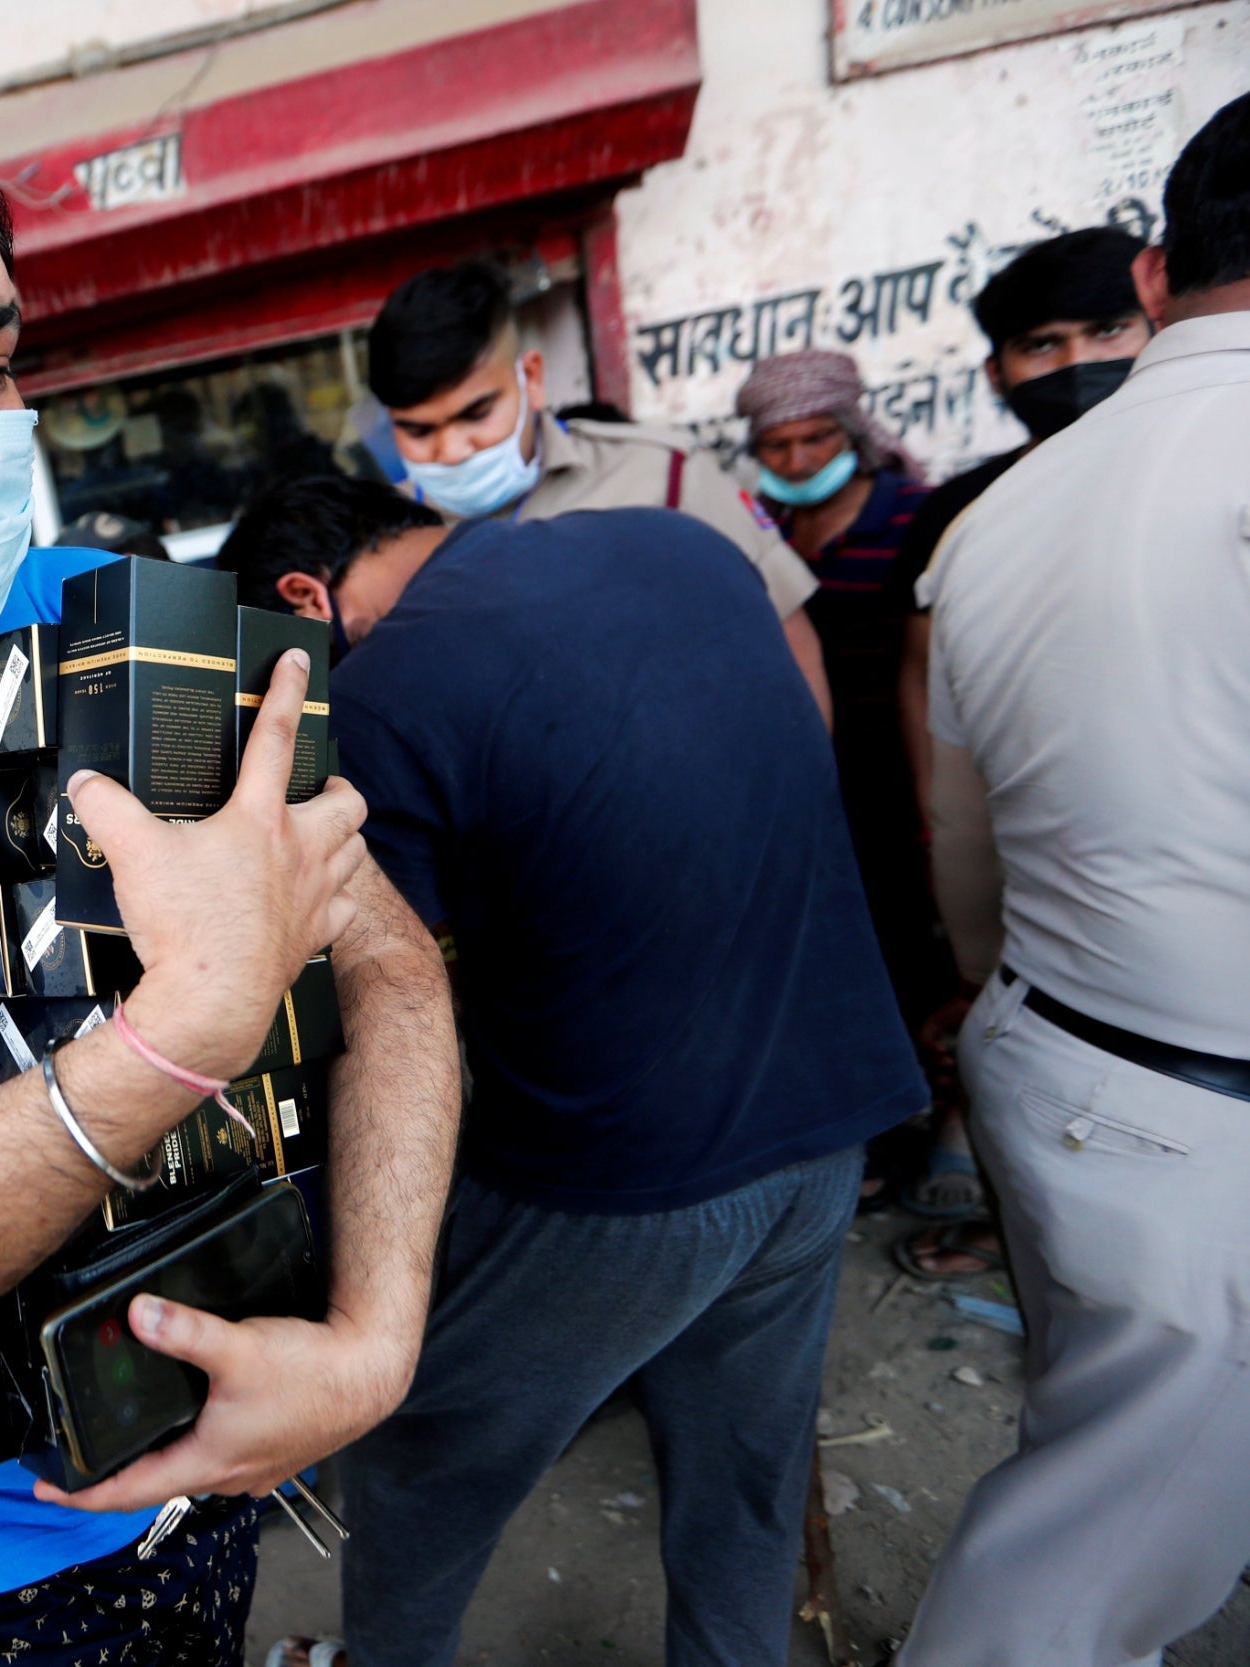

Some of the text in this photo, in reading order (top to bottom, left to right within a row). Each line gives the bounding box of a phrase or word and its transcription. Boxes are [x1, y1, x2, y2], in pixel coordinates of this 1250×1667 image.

[836, 261, 945, 344] आप
[137, 651, 187, 662] PERFECTION
[201, 658, 234, 669] BLENDED
[88, 682, 104, 695] 150
[170, 1130, 182, 1169] PRIDE
